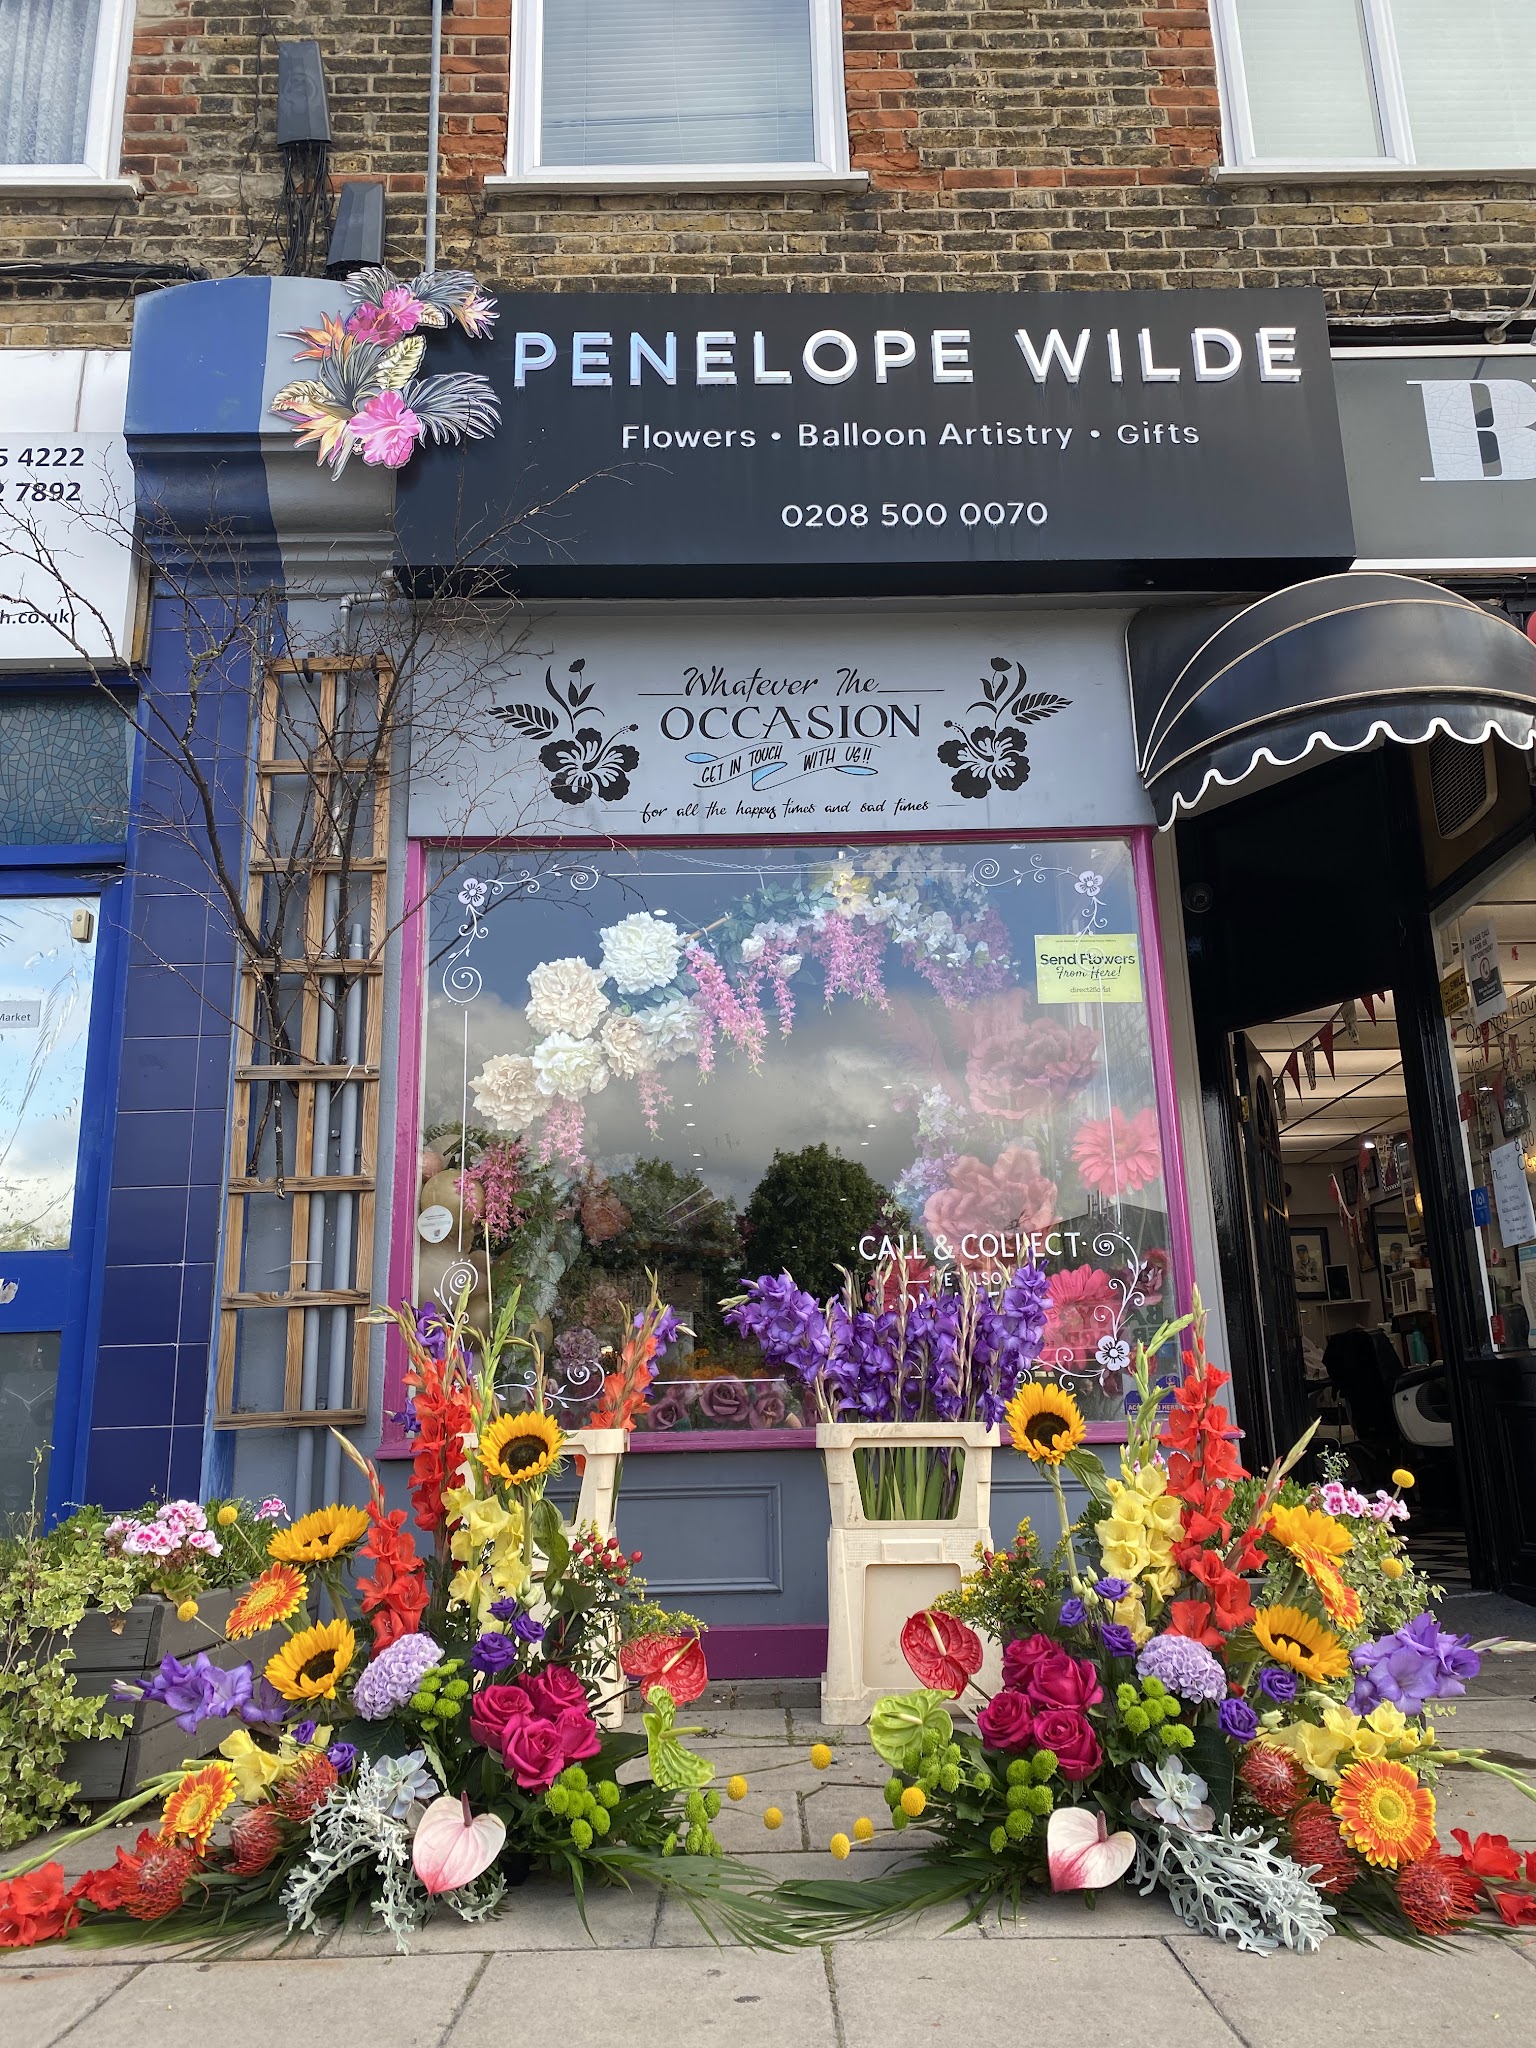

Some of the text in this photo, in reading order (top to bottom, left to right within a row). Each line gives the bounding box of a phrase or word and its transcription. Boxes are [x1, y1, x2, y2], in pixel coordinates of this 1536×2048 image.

[514, 327, 1302, 387] PENELOPE WILDE
[621, 420, 1200, 450] Flowers Balloon Artistry Gifts
[1406, 379, 1536, 481] B
[17, 447, 85, 467] 4222
[15, 482, 82, 502] 7892
[781, 501, 1048, 527] 0208 500 0070
[683, 665, 880, 702] Whatever The
[660, 703, 922, 740] OCCASION
[701, 745, 872, 783] GET IN TOUCH WITH US!!
[640, 798, 931, 824] for all the happy times and sad times
[1040, 953, 1136, 965] Send Flowers
[1056, 966, 1122, 979] From Here!
[1465, 1011, 1509, 1045] Opening
[858, 1234, 927, 1260] CALL
[933, 1234, 955, 1260] &
[968, 1271, 1002, 1287] LSO
